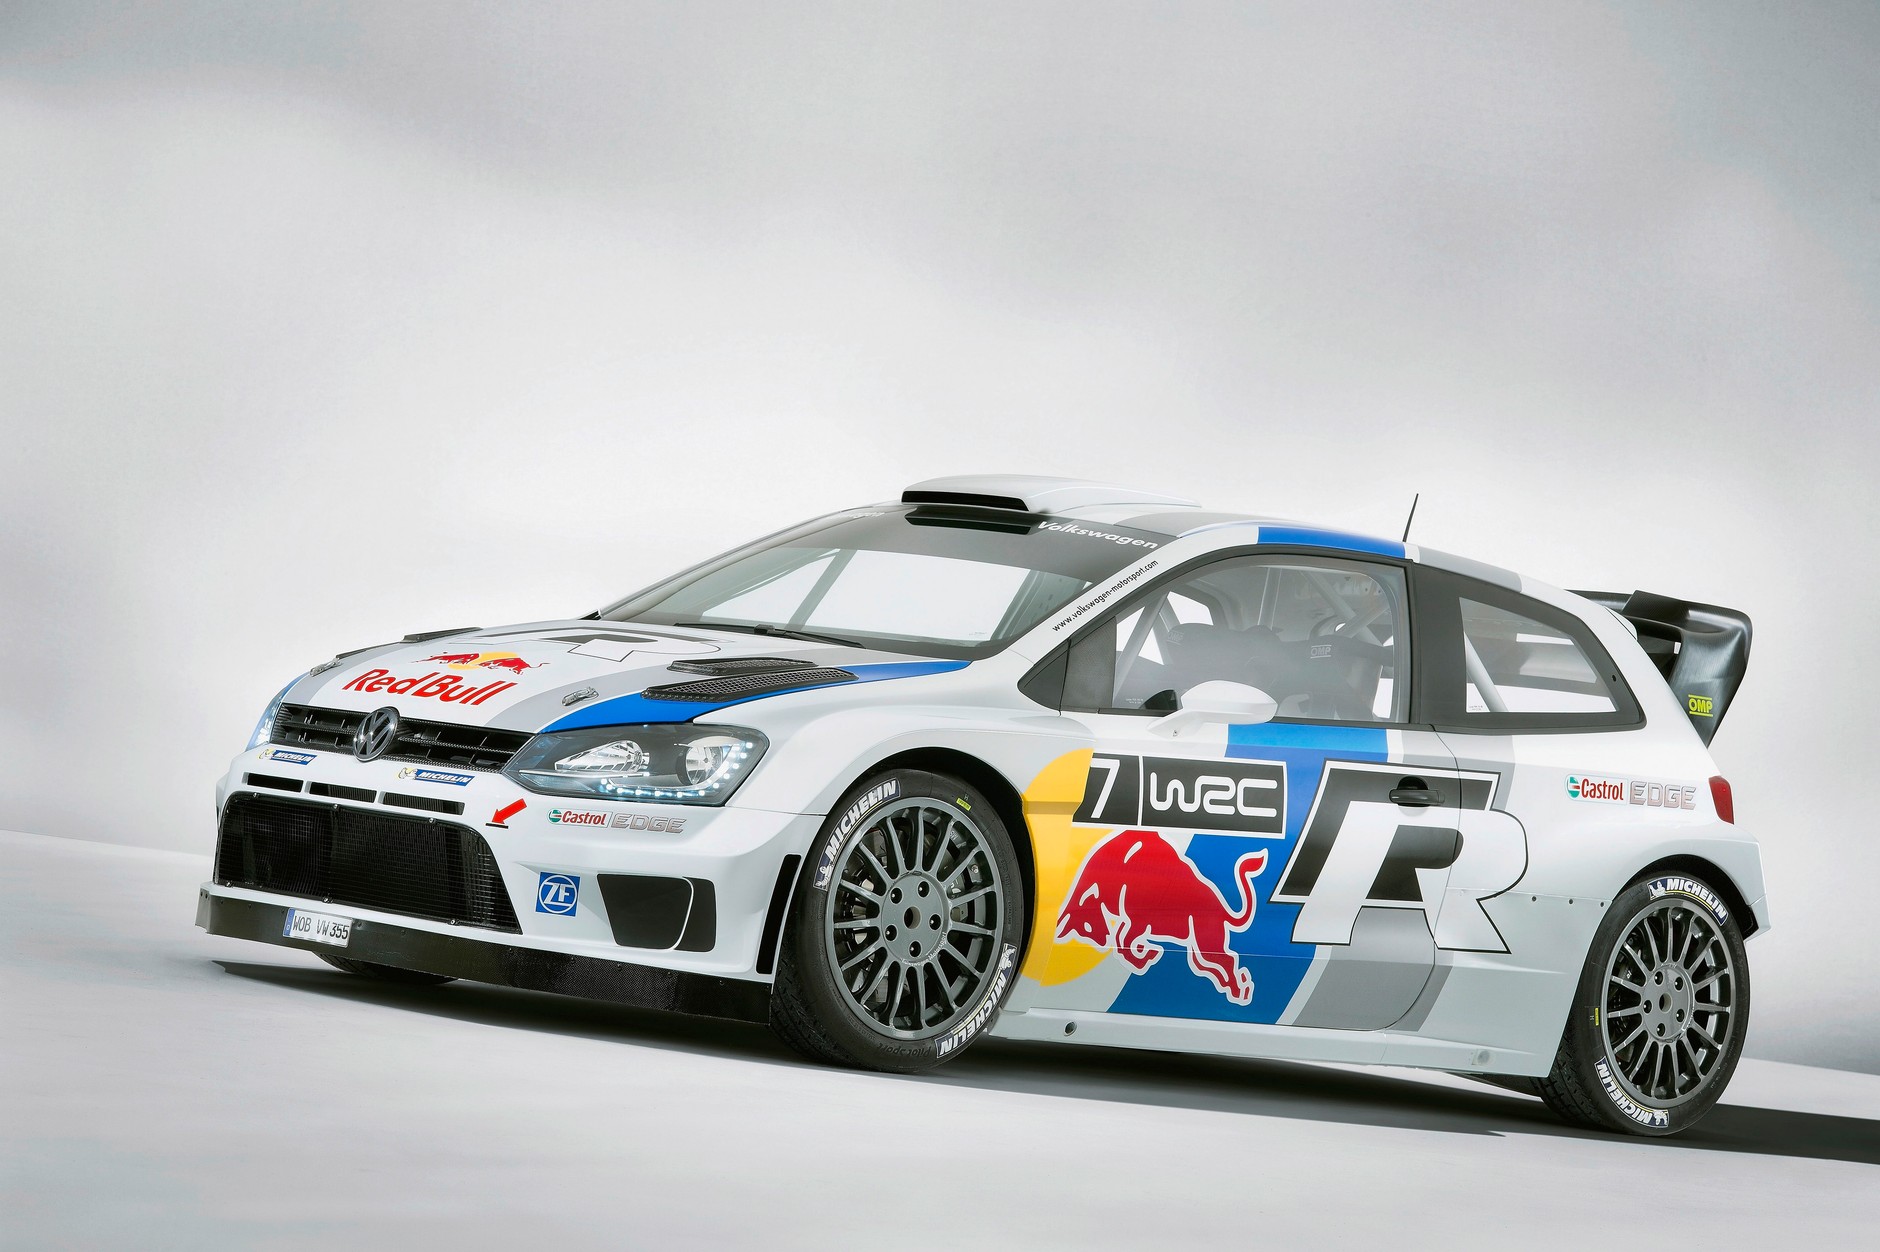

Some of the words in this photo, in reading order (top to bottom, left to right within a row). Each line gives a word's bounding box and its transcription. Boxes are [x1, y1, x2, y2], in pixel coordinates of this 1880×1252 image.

[1038, 521, 1158, 549] Volkswagen
[1052, 560, 1159, 632] www.volkswagen-motorsport.com
[1310, 646, 1332, 657] OMP
[1688, 698, 1713, 713] OMP
[418, 772, 472, 782] MICHELIN
[1090, 757, 1121, 819] 7
[1149, 771, 1278, 818] WRC
[1581, 778, 1624, 801] Castrol
[1629, 781, 1697, 810] EDGE
[562, 810, 607, 825] Castrol
[611, 813, 687, 833] EDGE
[825, 780, 897, 861] MICHELIN
[1269, 758, 1528, 954] R
[543, 881, 576, 907] ZF
[1666, 878, 1726, 918] MICHELIN
[293, 915, 312, 933] WOB
[316, 919, 331, 936] VW
[329, 922, 350, 940] 355
[939, 973, 1007, 1056] MICHELIN
[1596, 1063, 1653, 1124] MICHELIN
